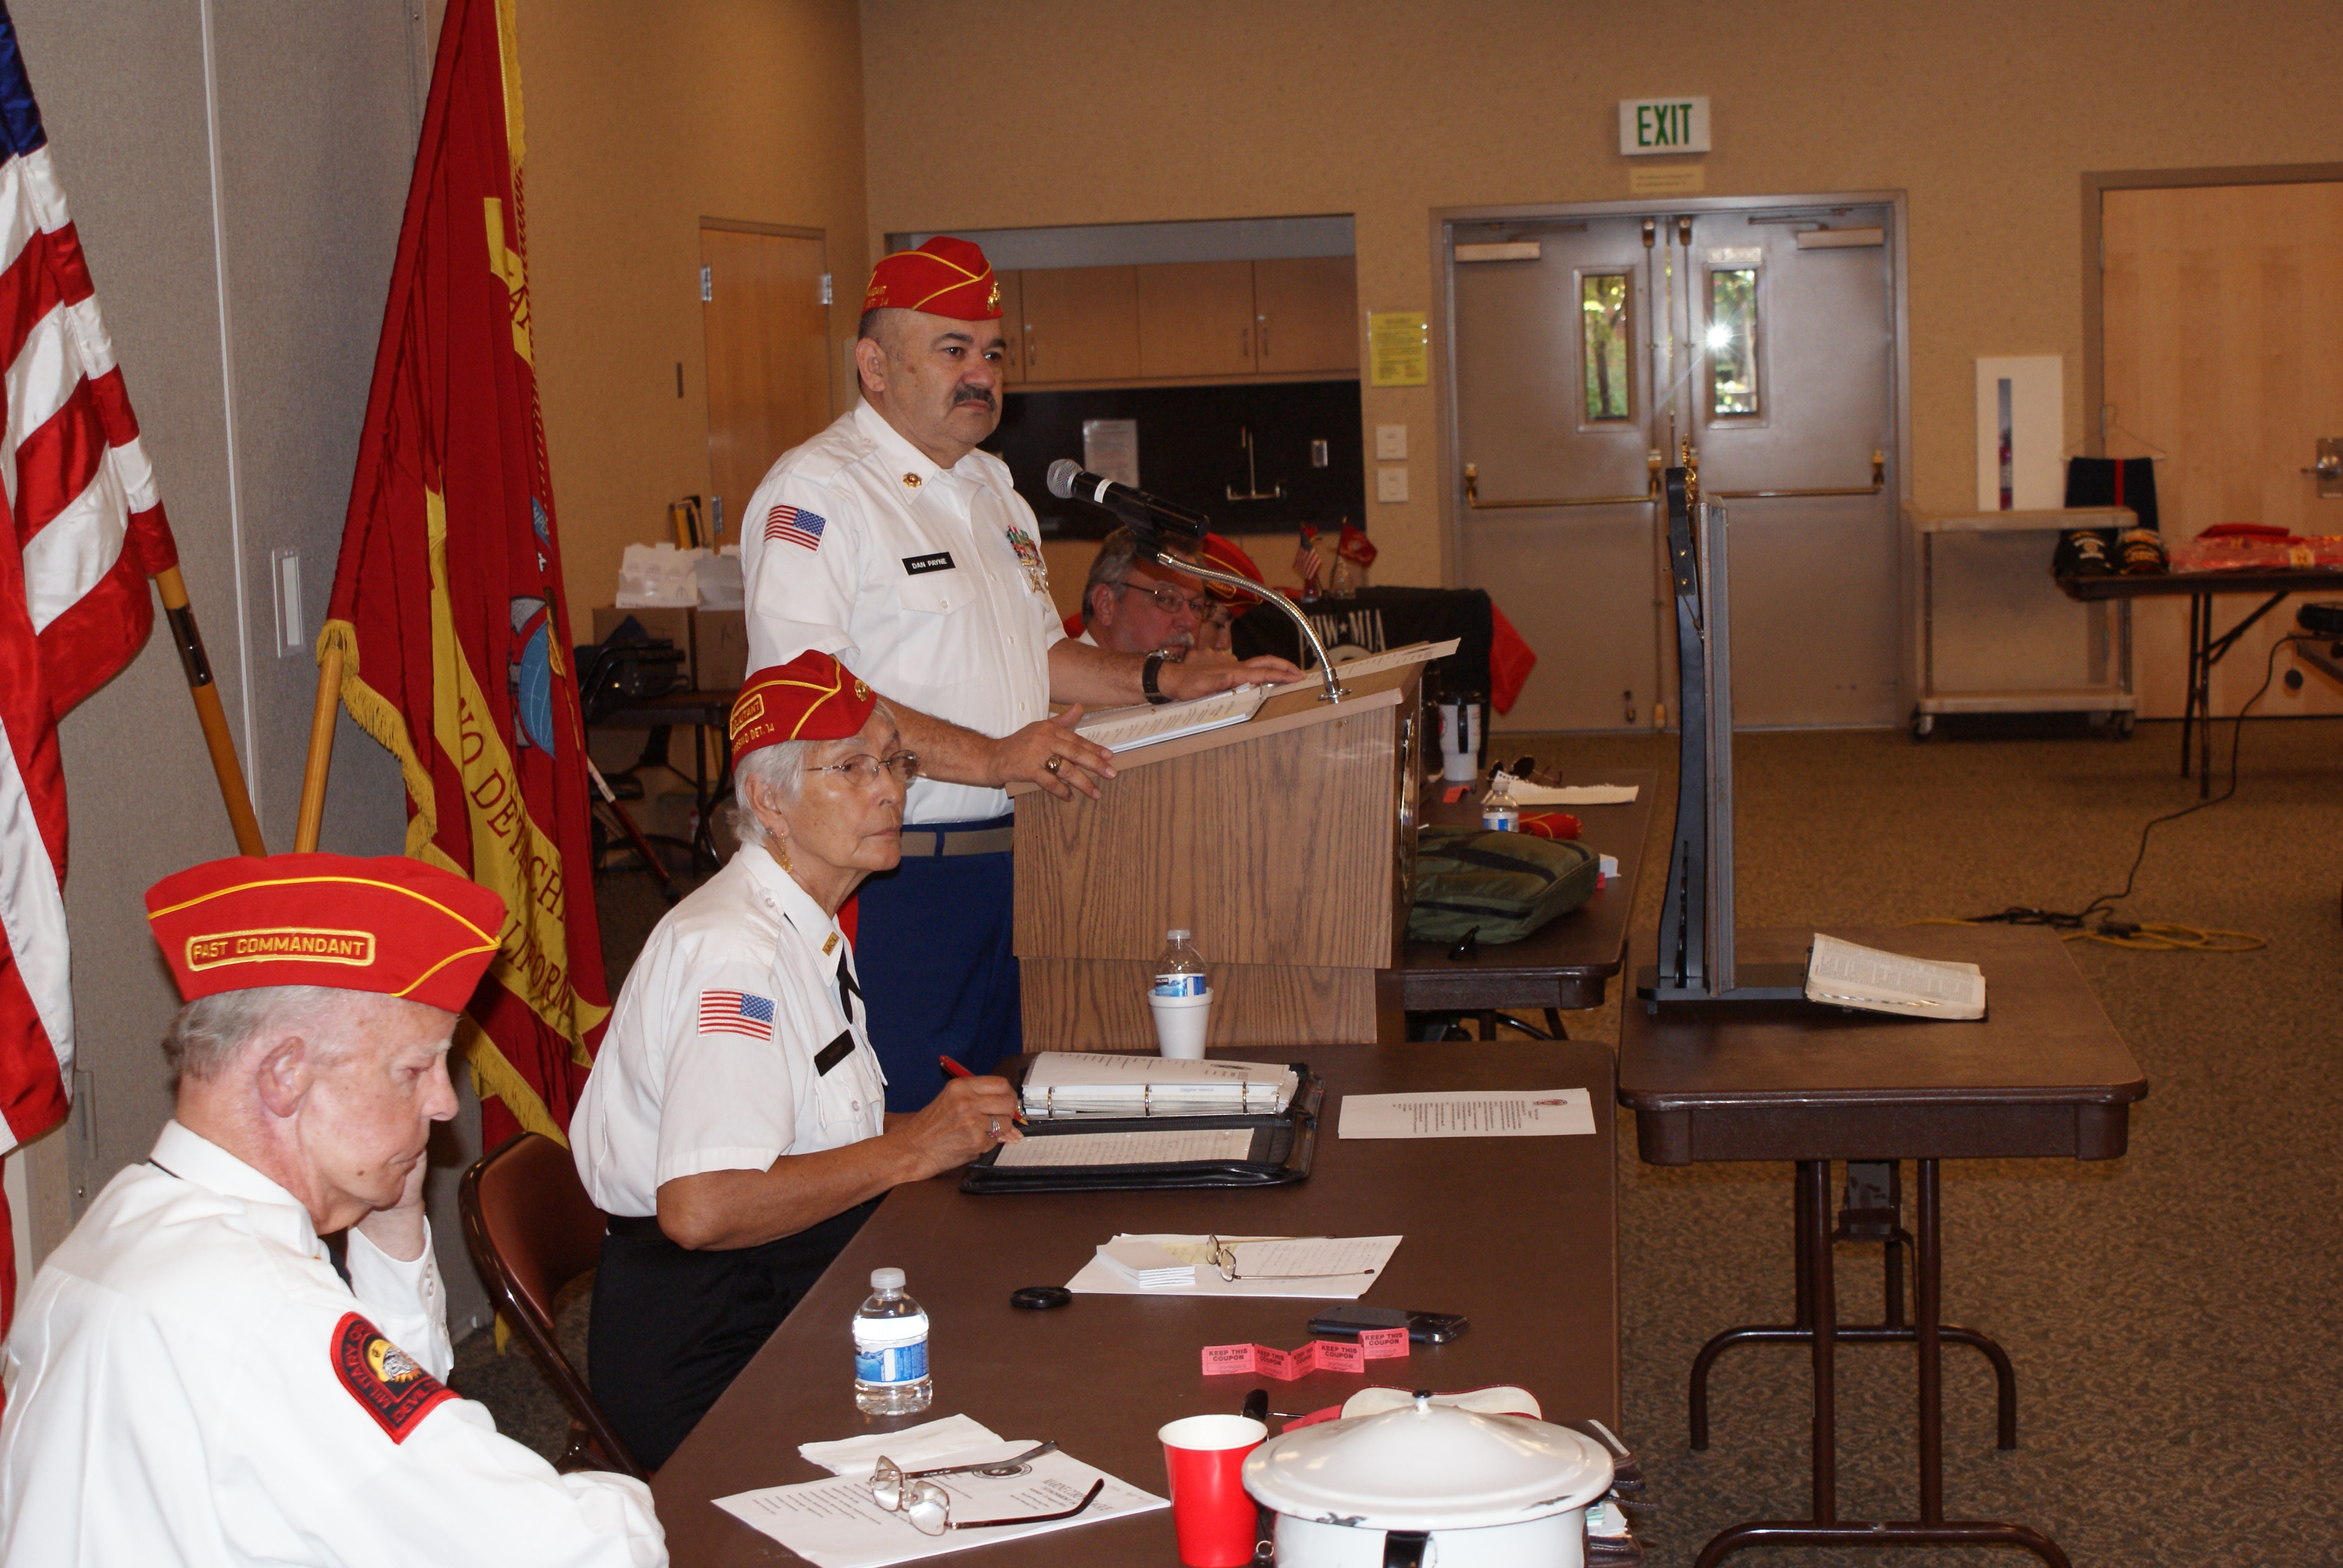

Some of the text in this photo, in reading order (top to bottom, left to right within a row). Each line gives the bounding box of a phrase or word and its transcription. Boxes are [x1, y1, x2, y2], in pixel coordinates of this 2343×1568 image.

[1636, 103, 1693, 146] EXIT
[911, 558, 947, 569] DAN PAYNE
[1349, 608, 1386, 654] MIA
[470, 768, 565, 923] DETACH
[192, 936, 365, 960] PAST COMMANDANT
[824, 937, 839, 953] MCL
[345, 1344, 392, 1410] MILITARY
[1260, 1356, 1282, 1365] COUPON
[391, 1387, 431, 1423] DEVIL
